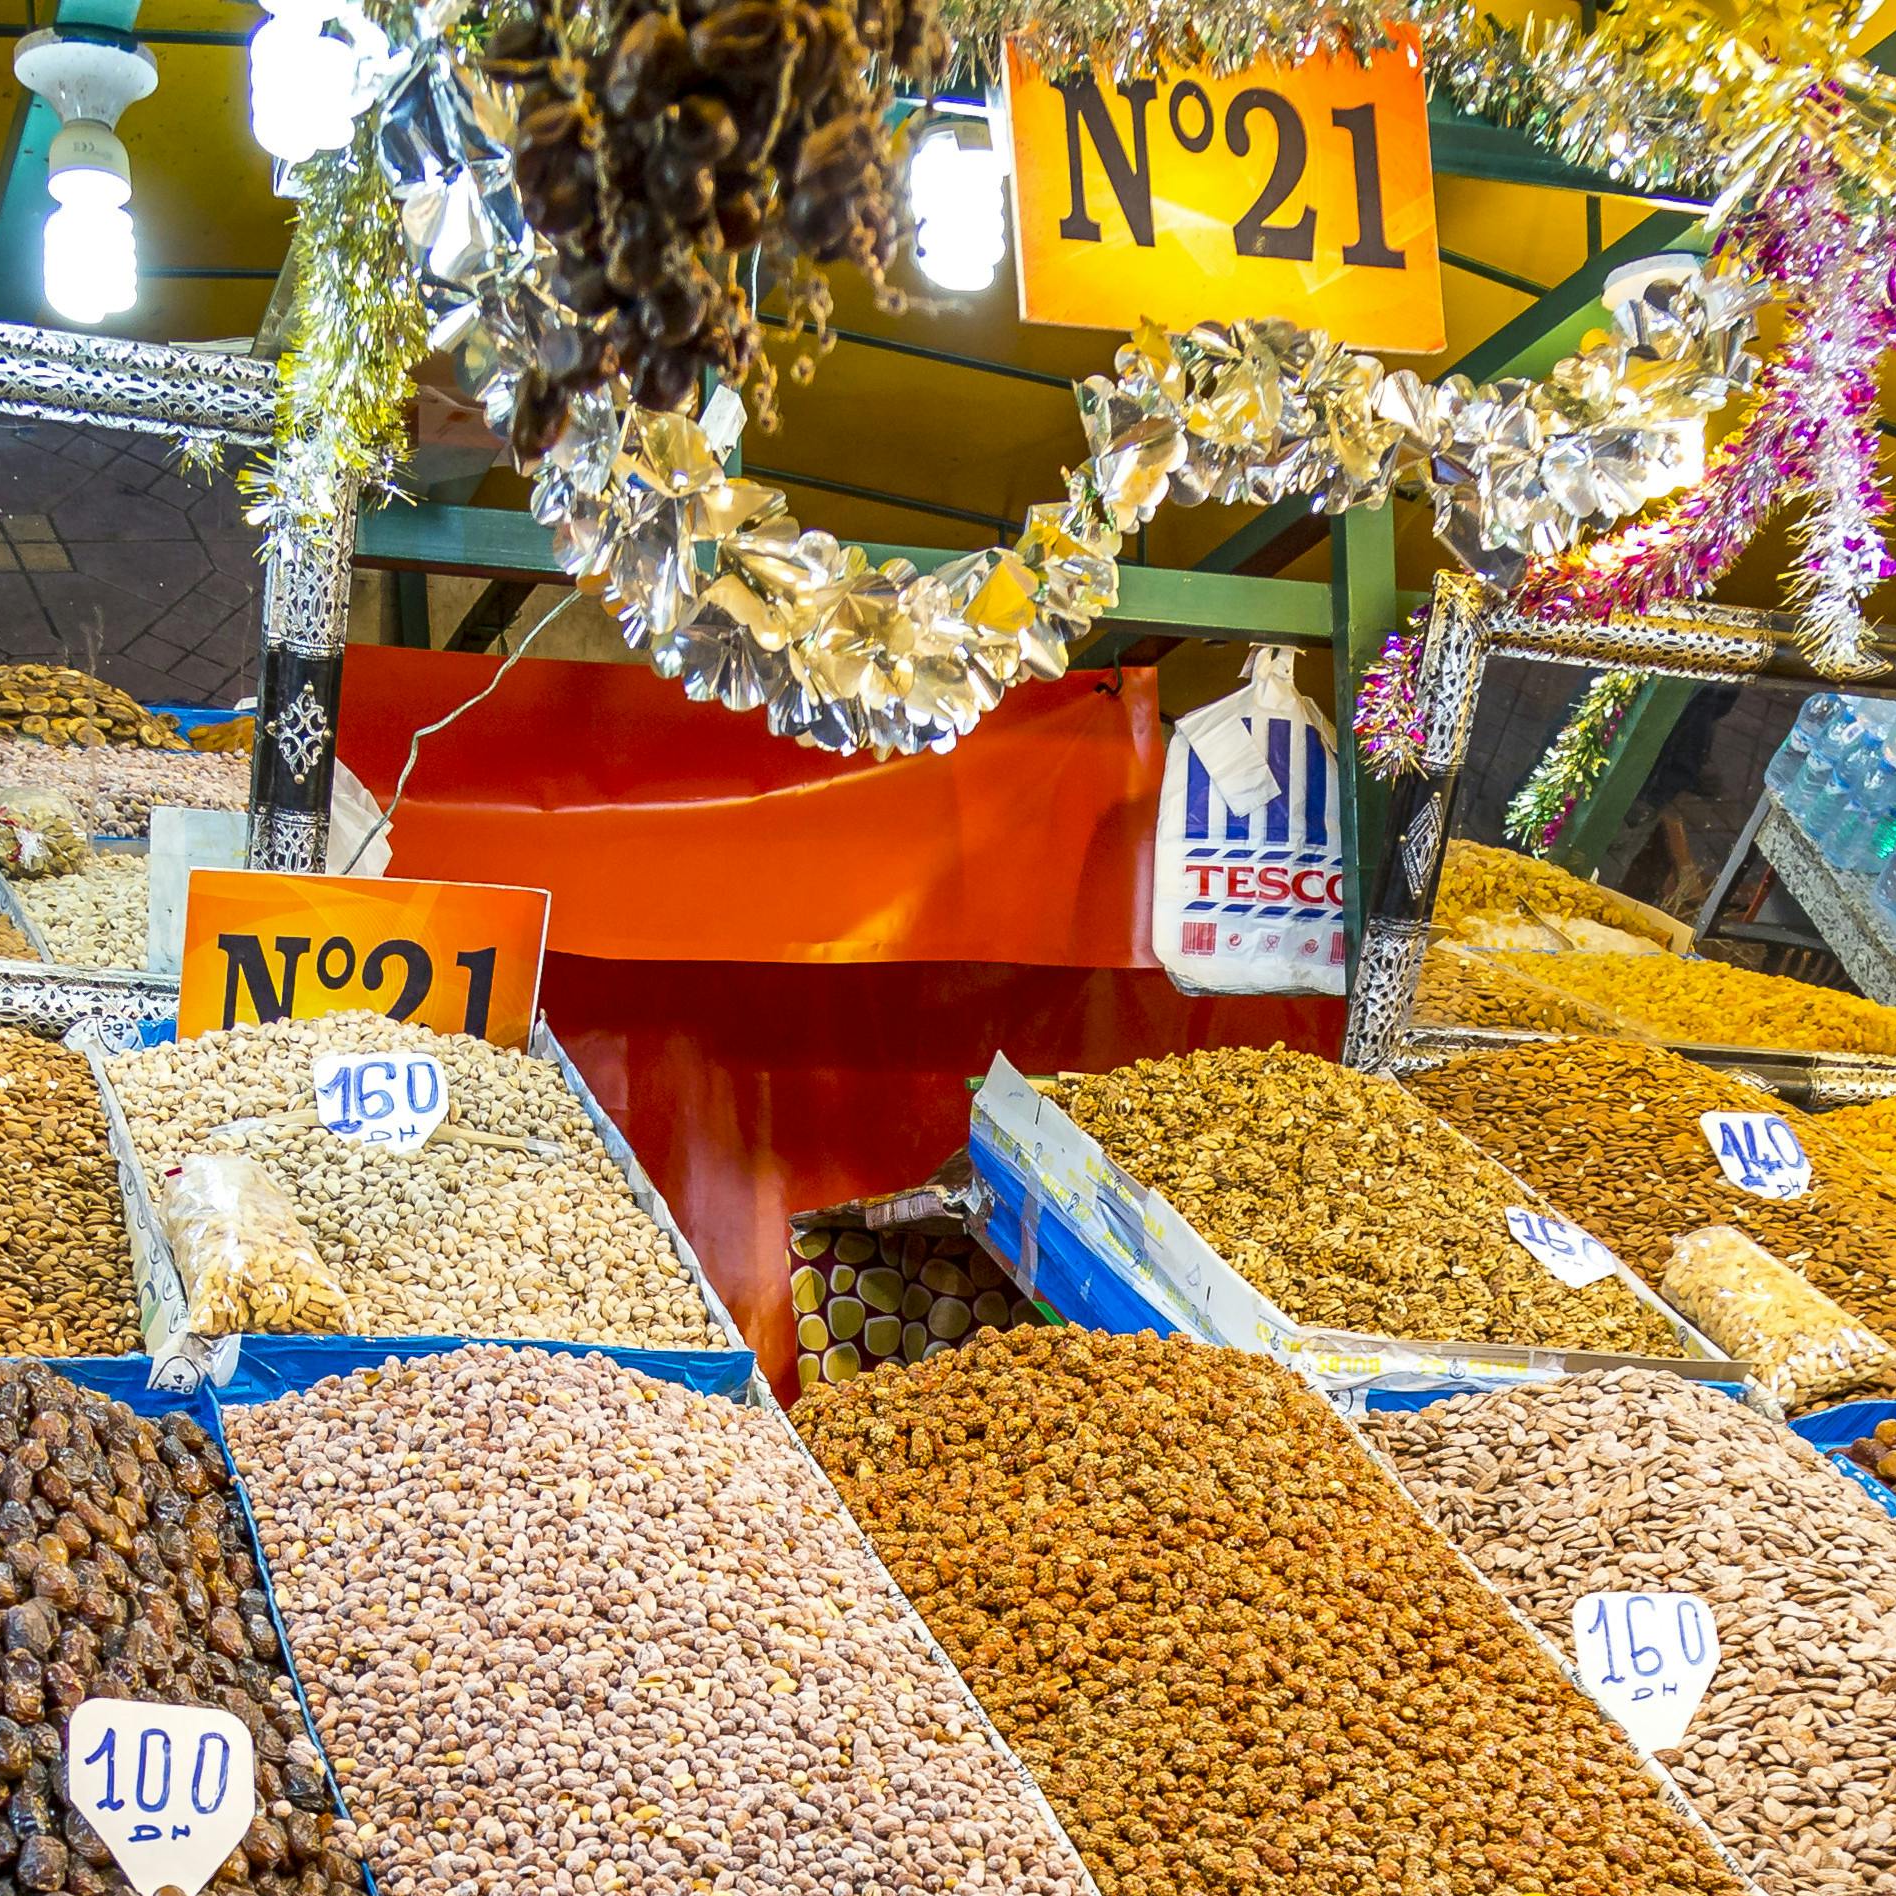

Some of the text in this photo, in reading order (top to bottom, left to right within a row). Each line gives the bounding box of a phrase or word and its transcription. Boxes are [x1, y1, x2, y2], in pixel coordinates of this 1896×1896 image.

[317, 1062, 439, 1135] 160
[365, 1124, 421, 1143] DH
[1776, 1178, 1801, 1198] DH
[1587, 1596, 1707, 1685] 160
[1631, 1682, 1678, 1701] DH
[84, 1727, 231, 1815] 100
[127, 1823, 192, 1843] DH
